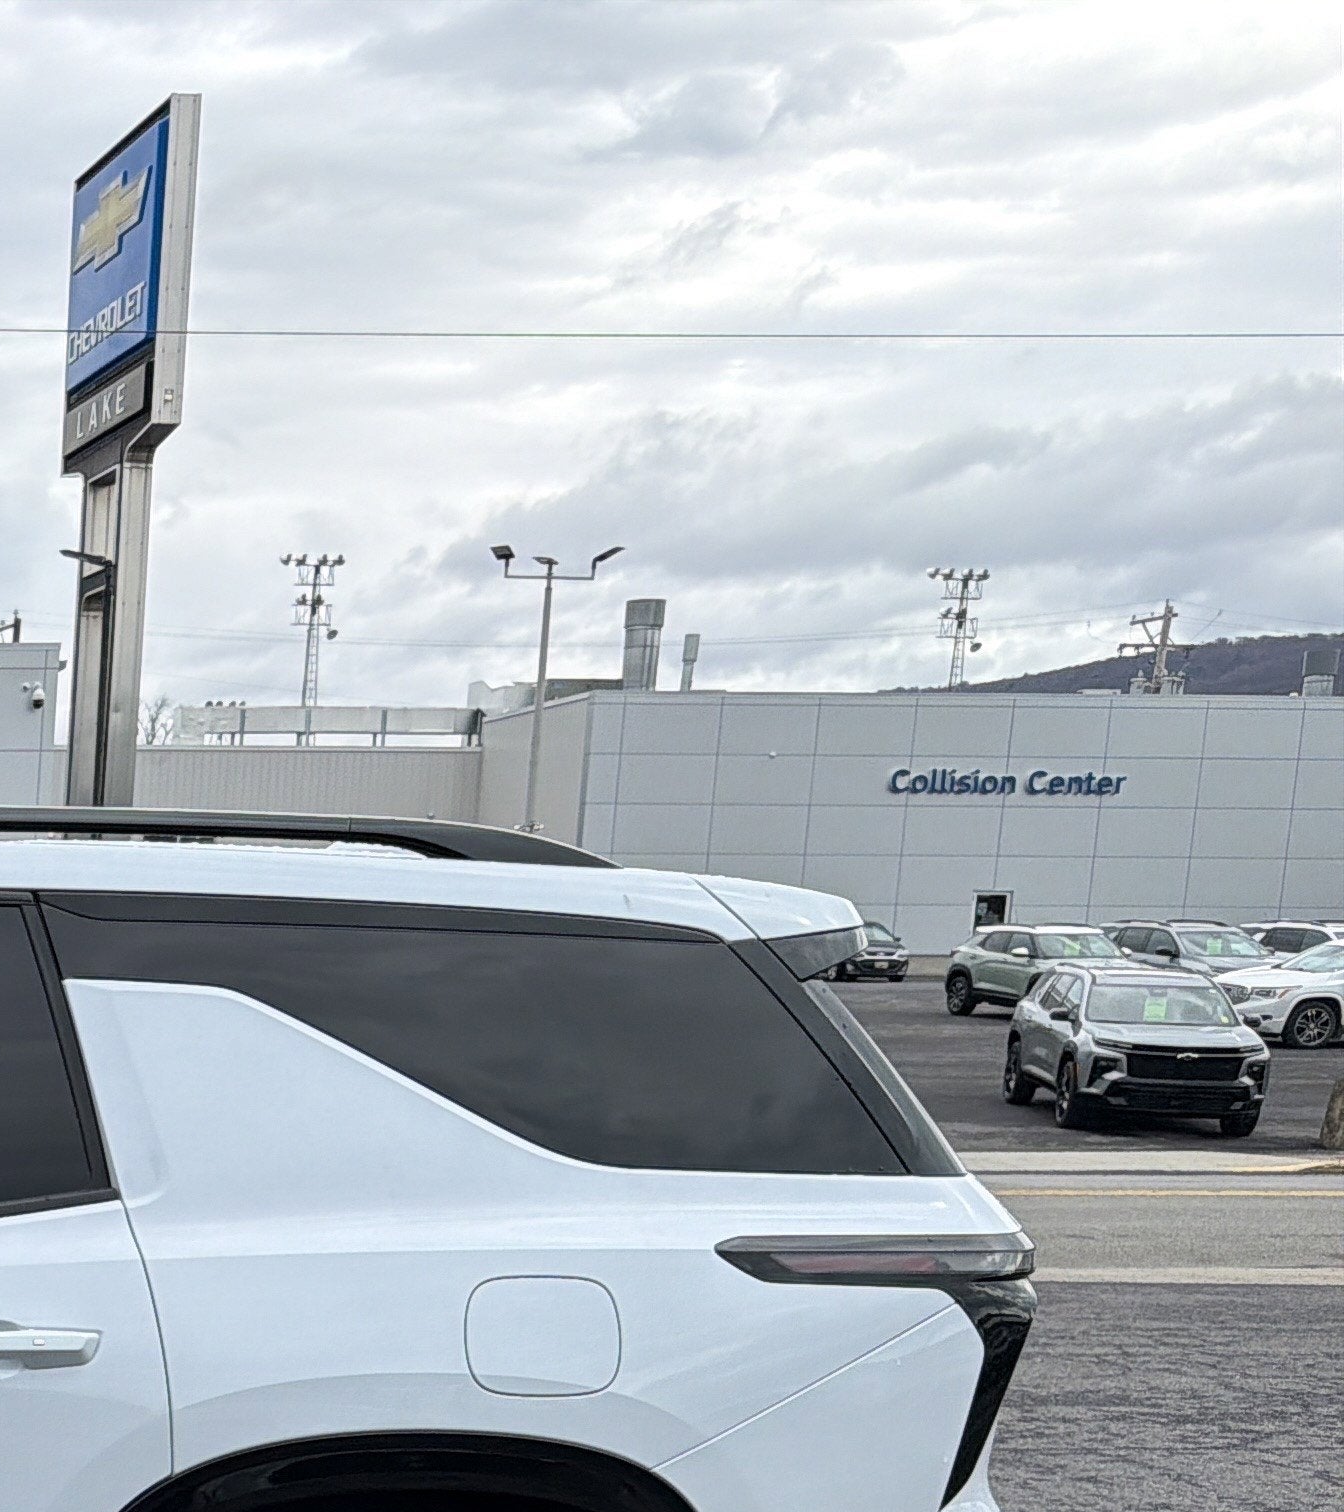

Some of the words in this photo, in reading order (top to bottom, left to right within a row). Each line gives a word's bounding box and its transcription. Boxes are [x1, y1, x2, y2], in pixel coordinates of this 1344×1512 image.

[67, 280, 146, 366] CHEVROLET
[74, 382, 128, 440] LAKE
[889, 768, 1017, 795] Collision
[1025, 770, 1128, 796] Center
